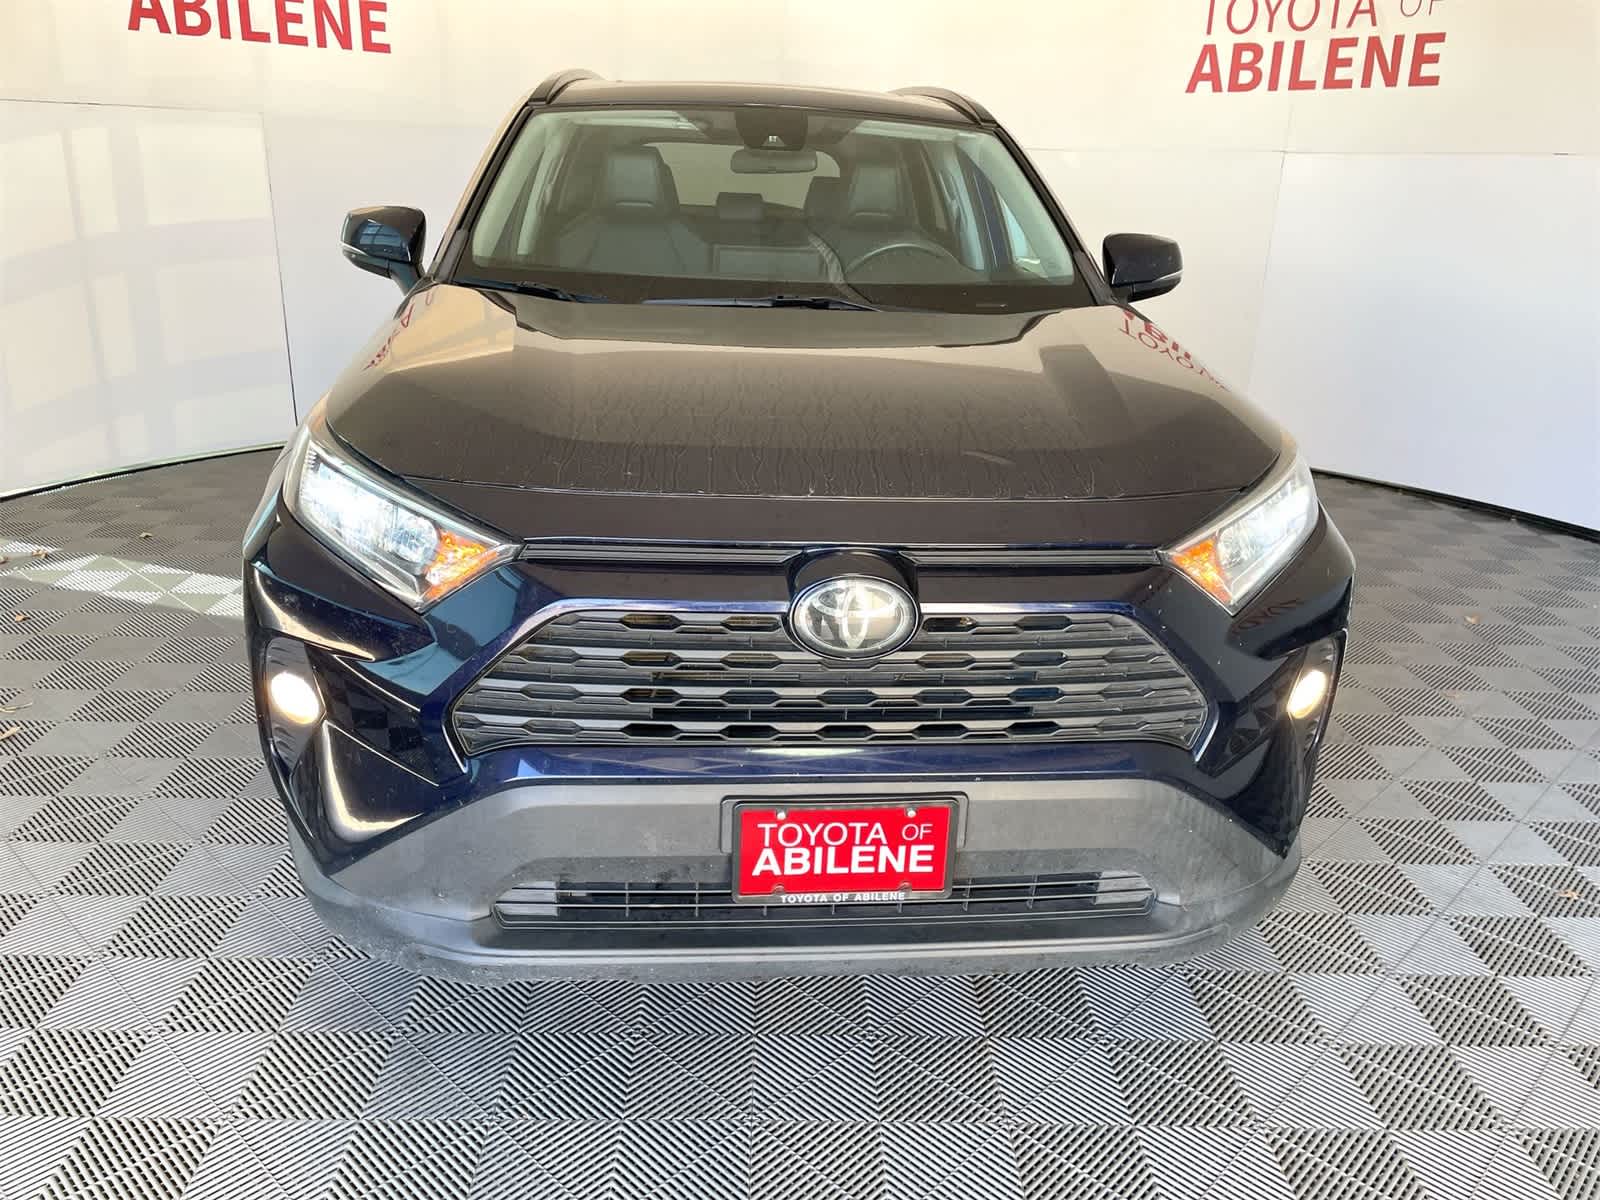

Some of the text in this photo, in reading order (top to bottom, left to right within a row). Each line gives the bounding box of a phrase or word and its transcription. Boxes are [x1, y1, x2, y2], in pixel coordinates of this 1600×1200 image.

[127, 0, 392, 54] ABILENE
[1185, 32, 1446, 93] ABILENE
[757, 822, 933, 847] TOYOTA OF
[752, 844, 935, 876] ABILENE
[780, 891, 905, 903] TOYOTA OF ABILENE
